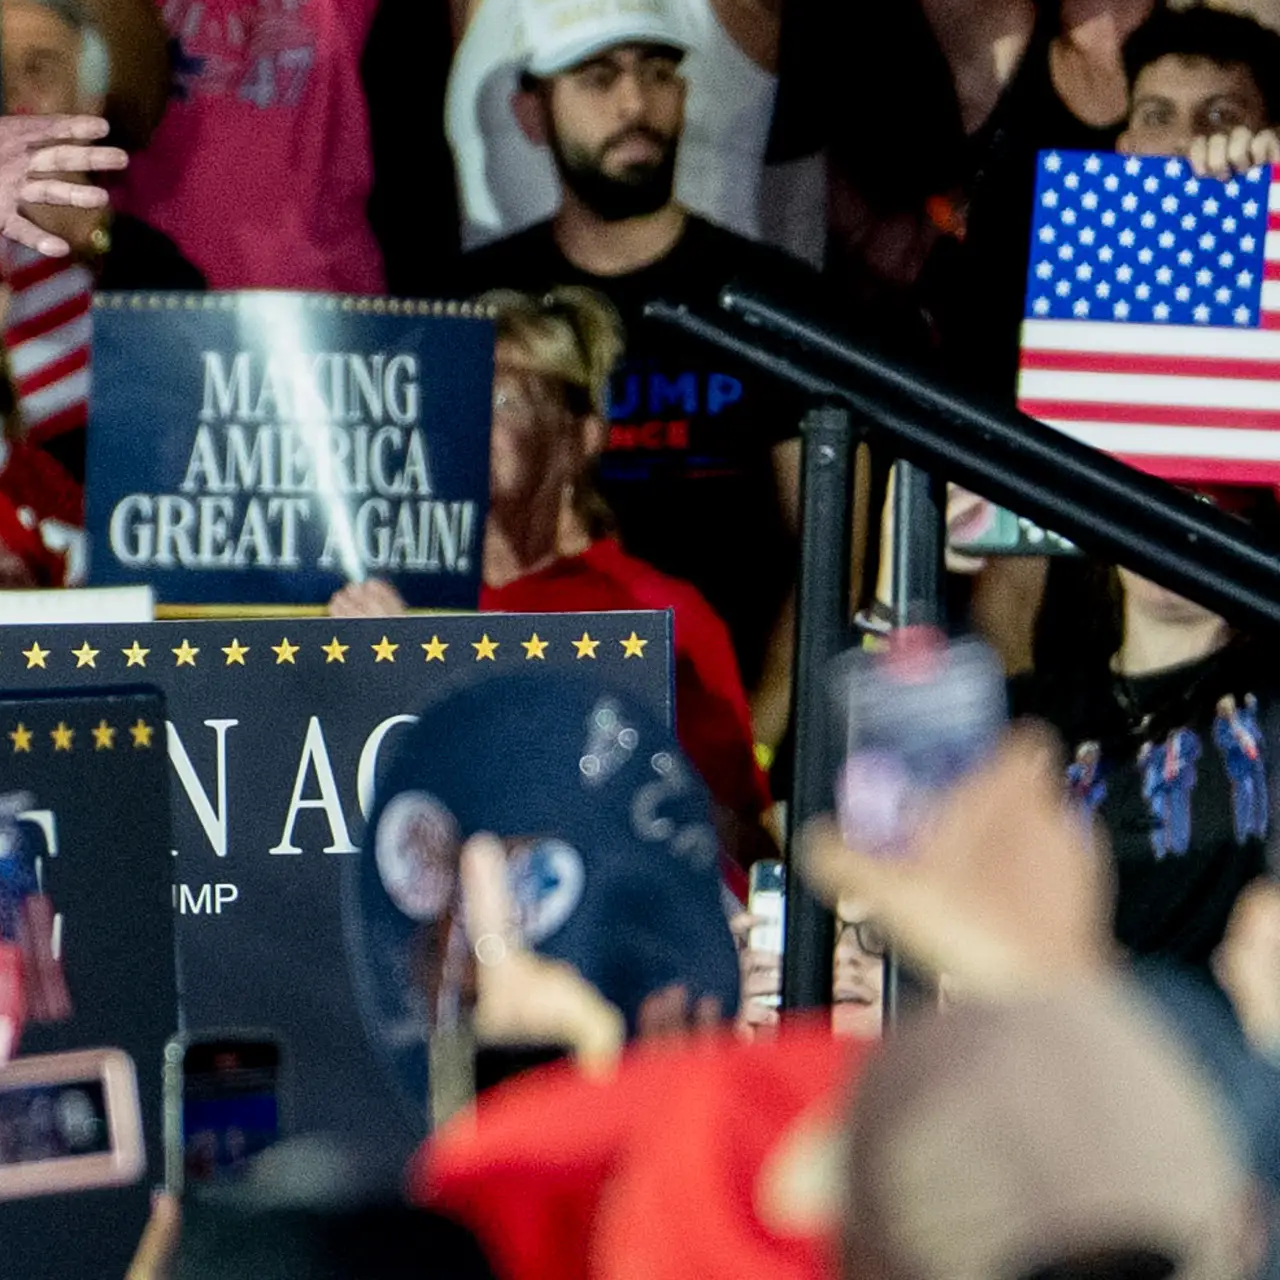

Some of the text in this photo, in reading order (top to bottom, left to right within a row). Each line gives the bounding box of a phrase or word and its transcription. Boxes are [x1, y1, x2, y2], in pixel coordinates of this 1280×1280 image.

[201, 350, 421, 423] MAKING
[181, 424, 433, 494] AMERICA
[109, 492, 475, 574] GREAT AGAIN!
